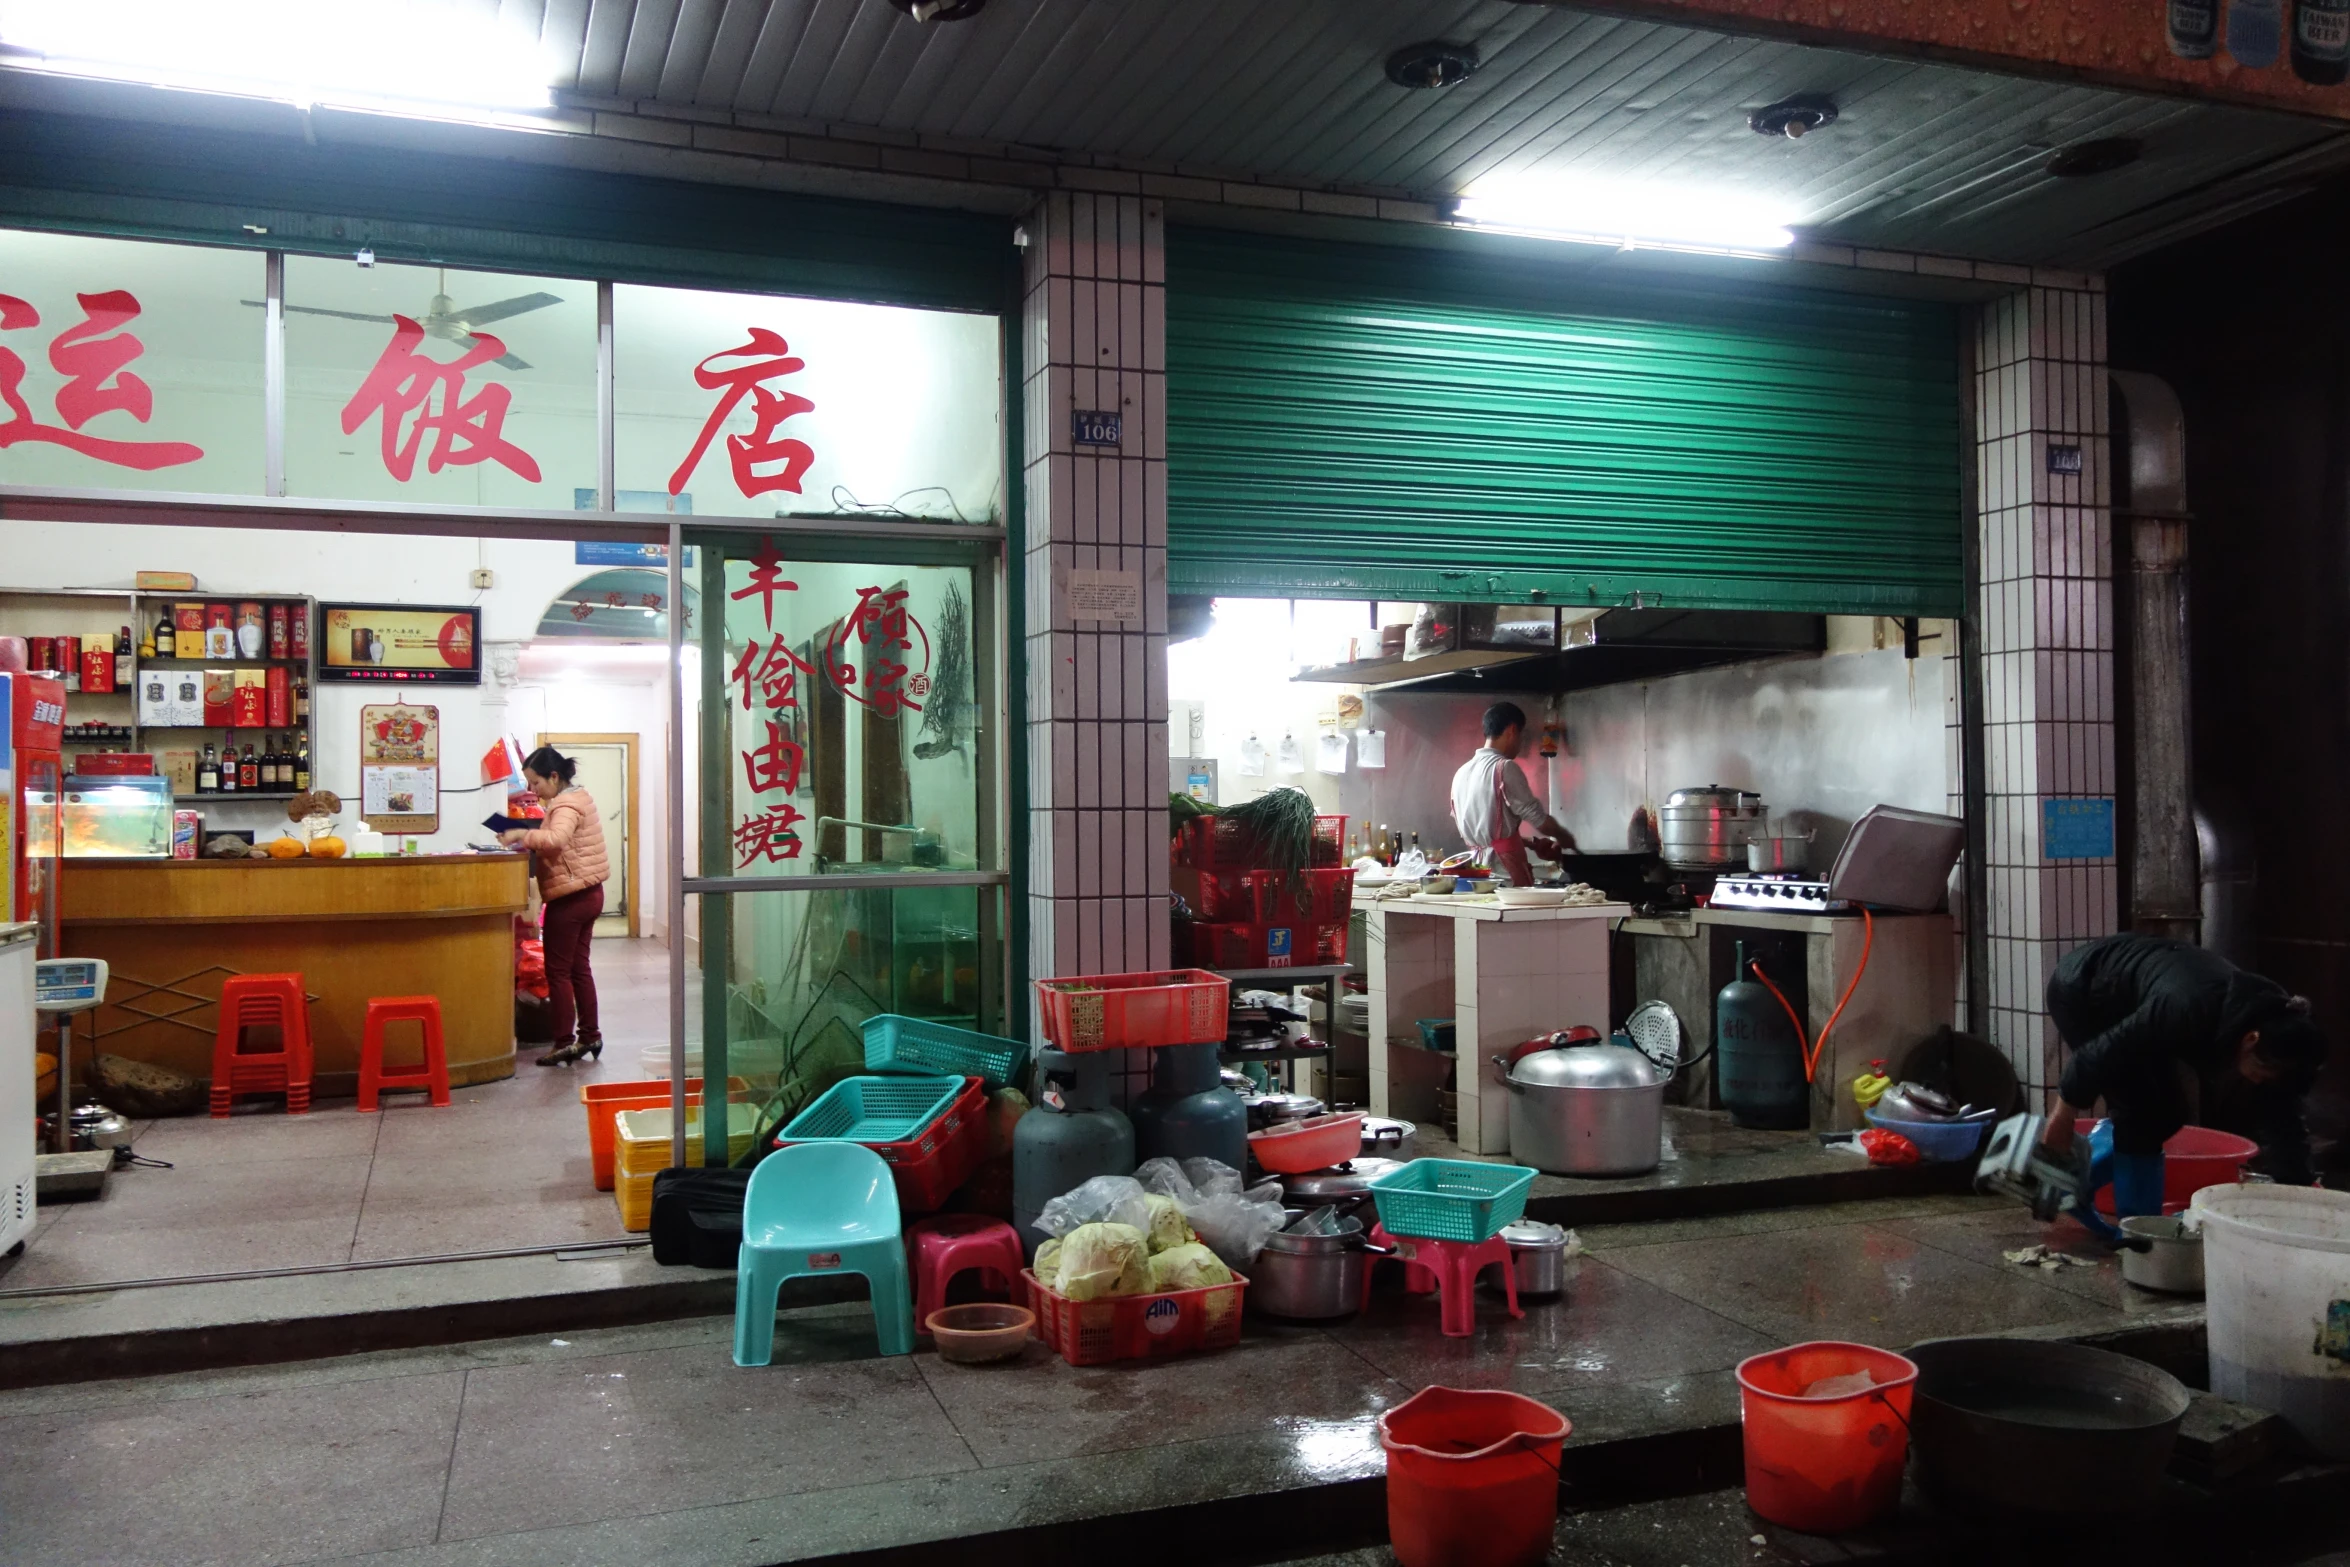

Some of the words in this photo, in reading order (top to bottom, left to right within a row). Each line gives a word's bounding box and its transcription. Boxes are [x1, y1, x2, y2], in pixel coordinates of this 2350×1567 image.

[2302, 11, 2345, 28] TAIWAN
[2307, 24, 2341, 42] BEER
[1083, 424, 1117, 442] 106
[910, 674, 930, 695] 酒
[1270, 957, 1289, 968] AAA
